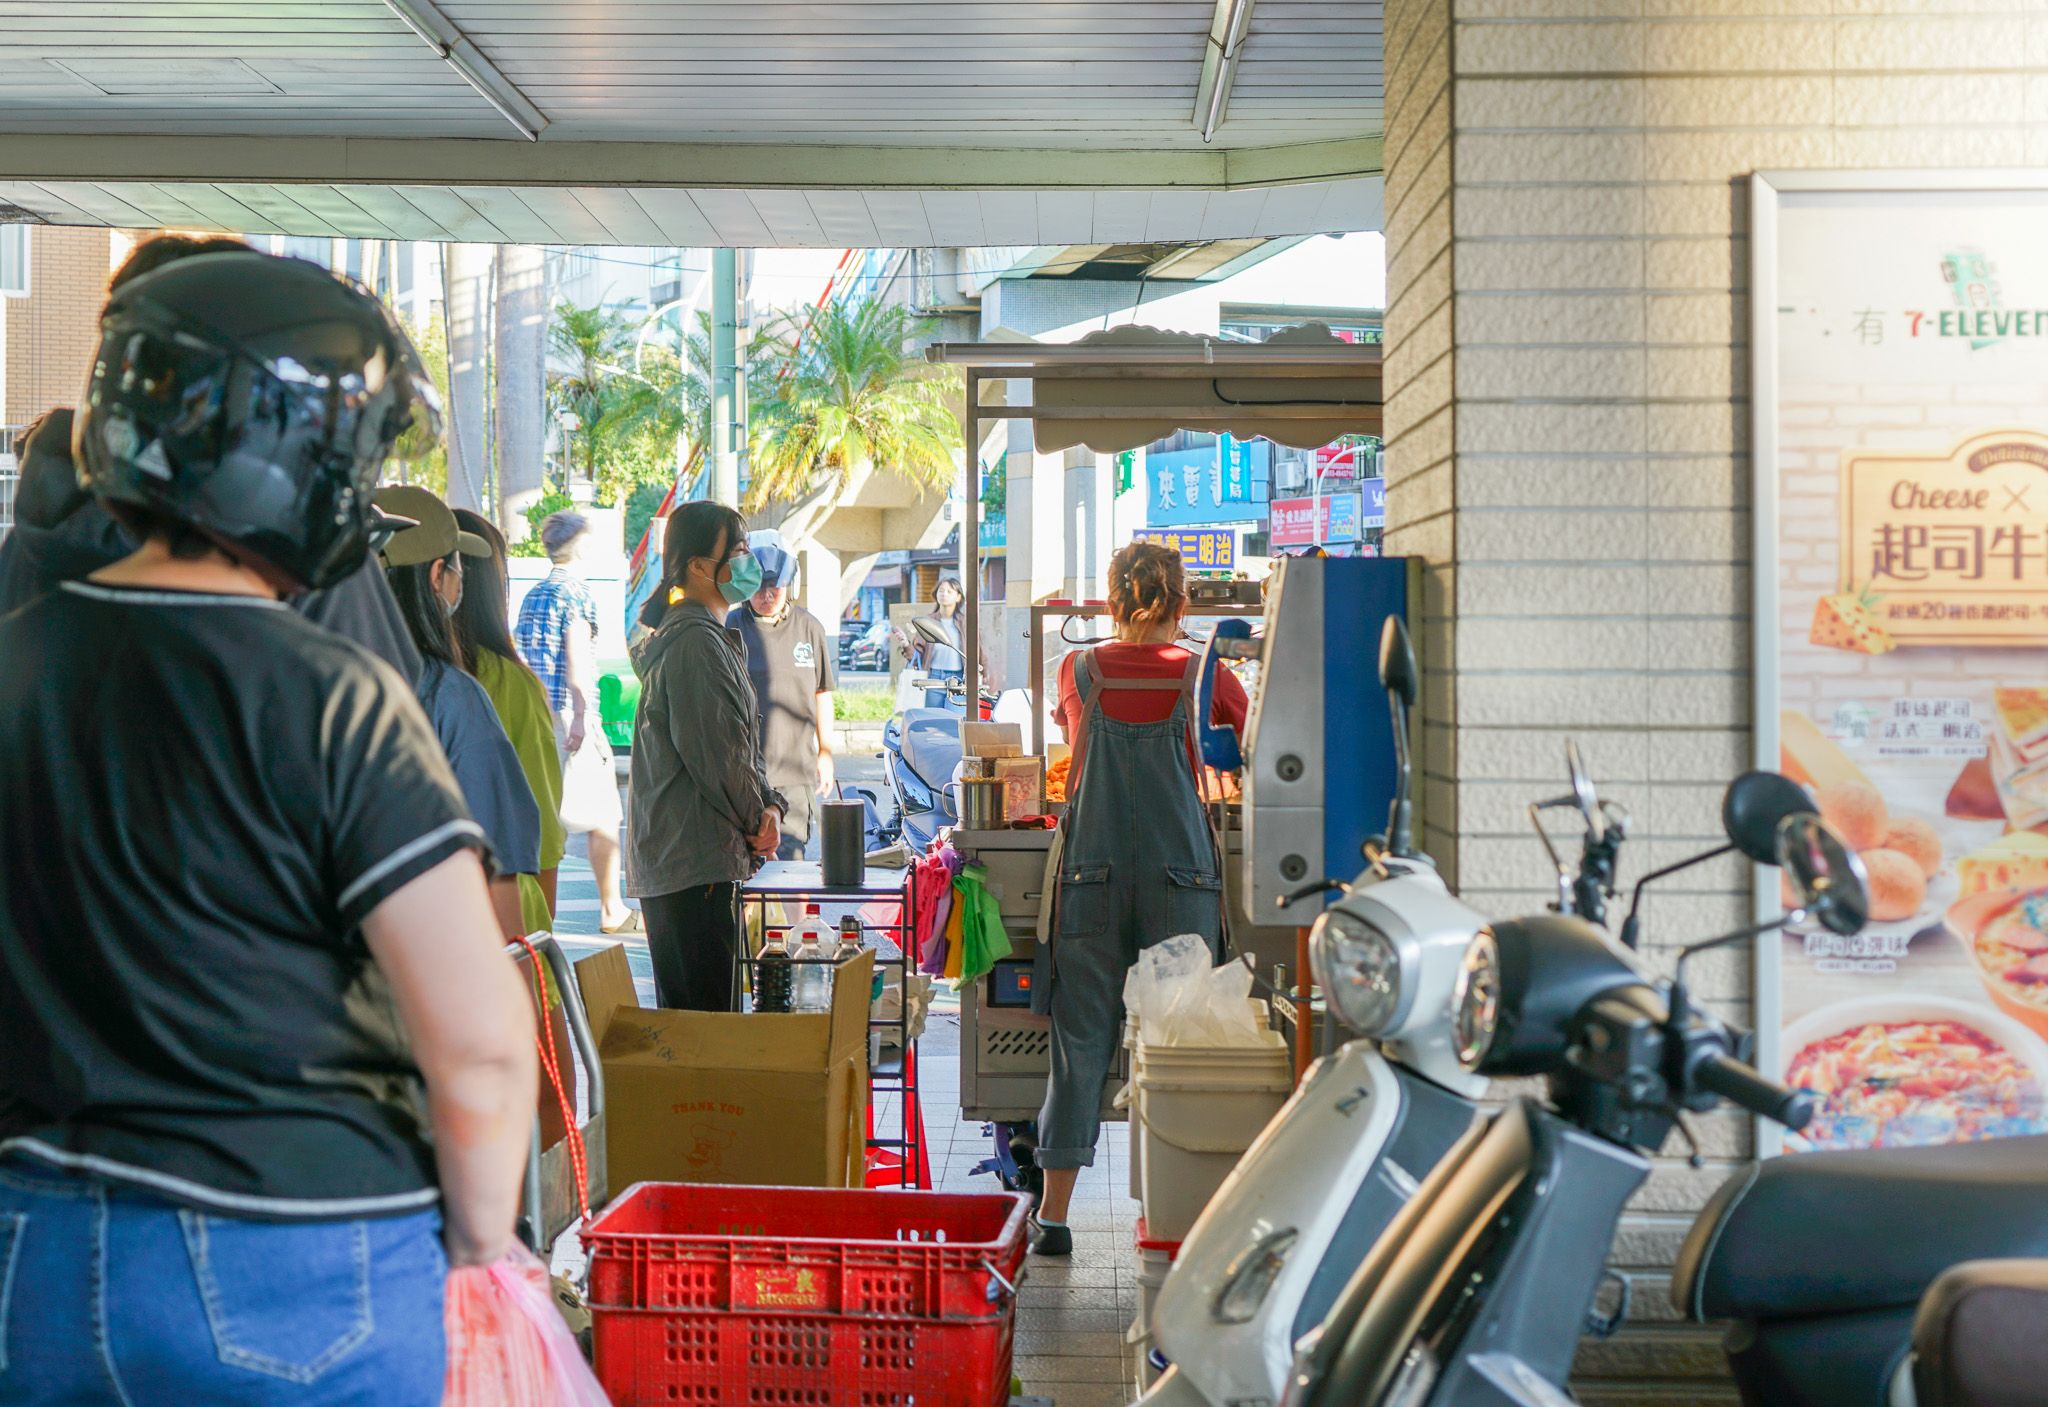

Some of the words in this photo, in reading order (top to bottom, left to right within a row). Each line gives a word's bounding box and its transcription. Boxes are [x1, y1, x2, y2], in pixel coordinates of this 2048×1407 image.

[1852, 305, 1888, 345] 有
[1891, 480, 1990, 510] Cheese
[1872, 523, 2048, 581] 起司牛
[672, 1101, 716, 1114] THANK
[719, 1102, 745, 1117] YOU
